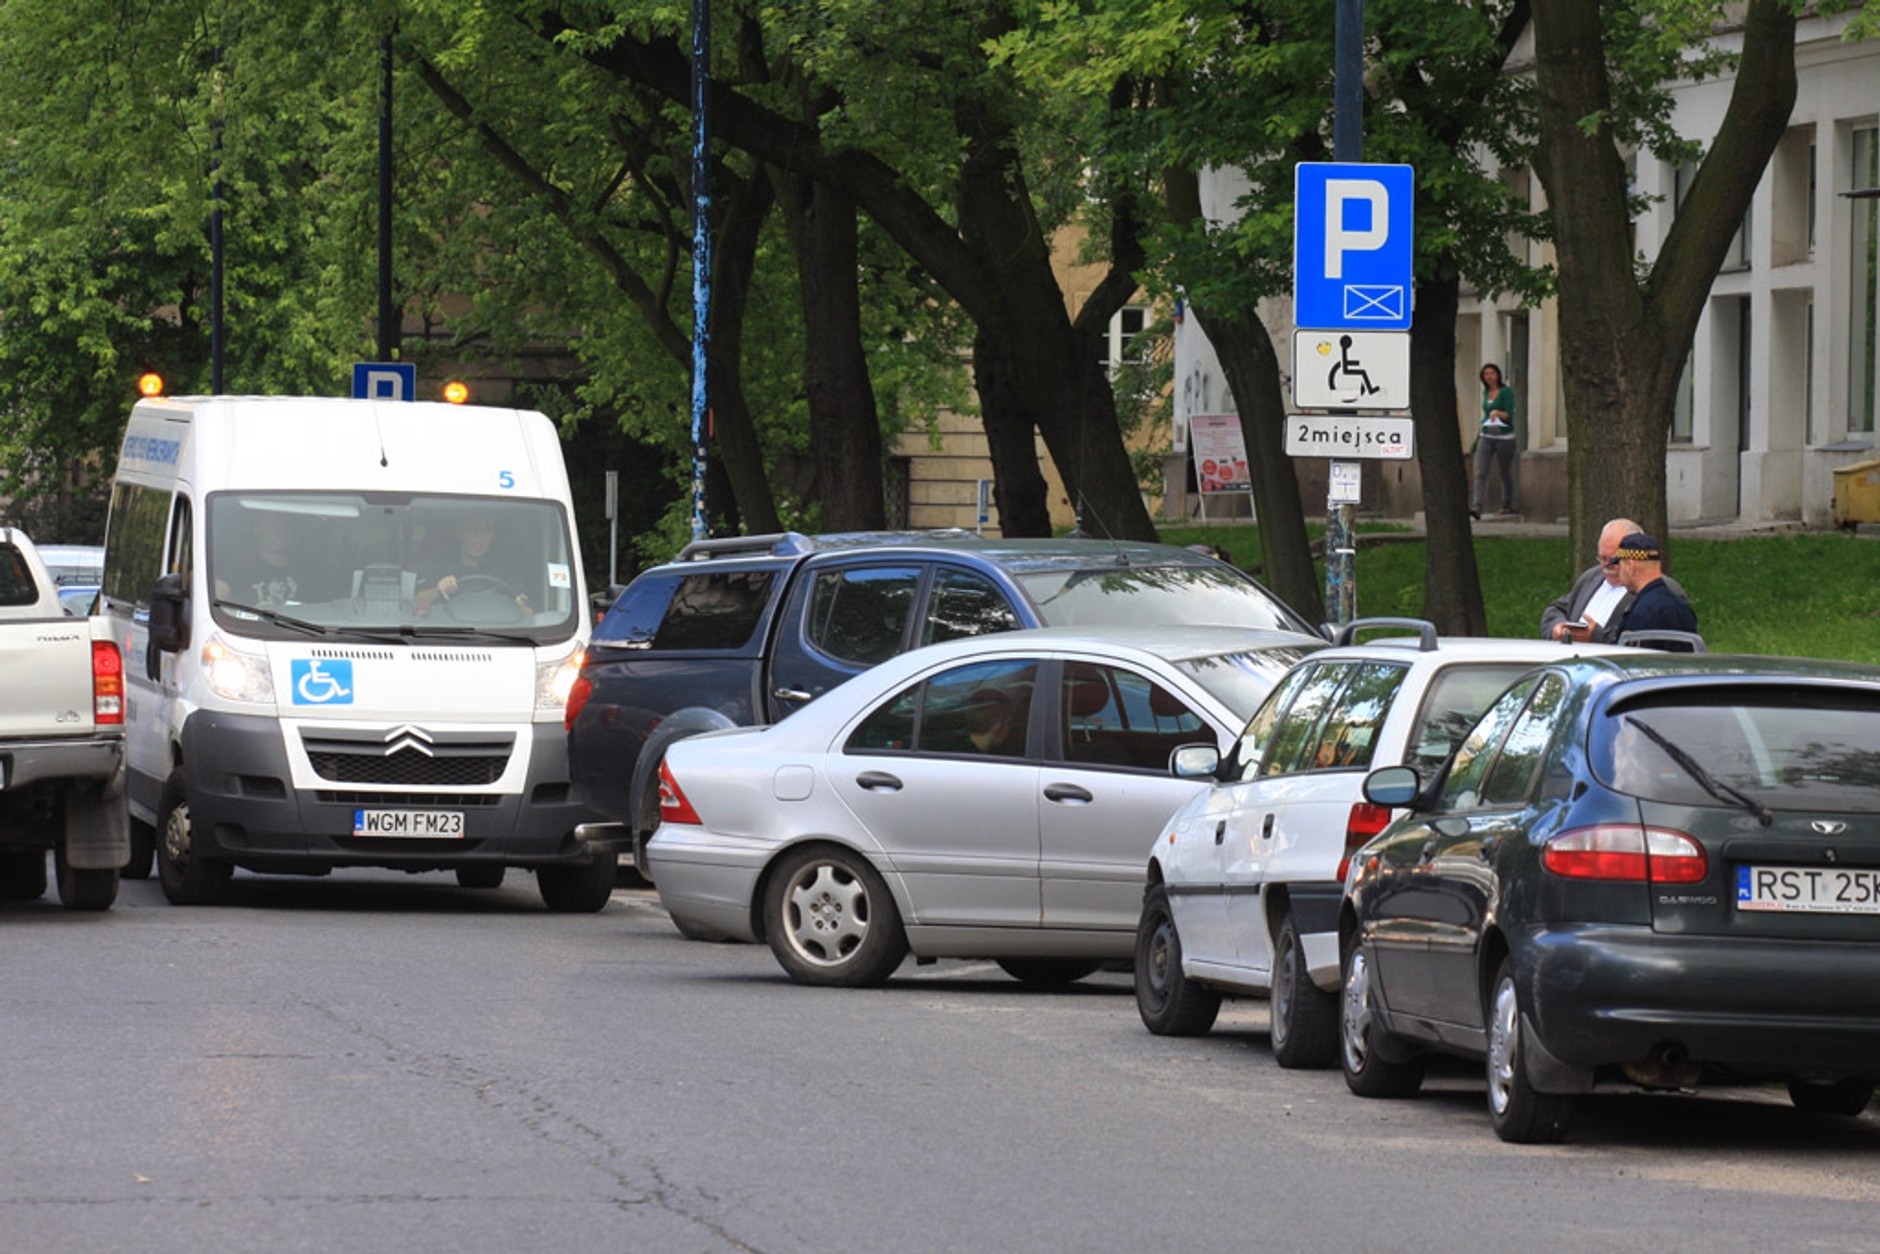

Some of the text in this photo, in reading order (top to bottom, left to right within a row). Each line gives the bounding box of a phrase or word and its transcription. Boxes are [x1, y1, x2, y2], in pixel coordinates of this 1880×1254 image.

[1324, 179, 1389, 279] P
[499, 470, 515, 489] 5
[367, 813, 461, 833] WGM FM23
[1757, 871, 1822, 901] RST
